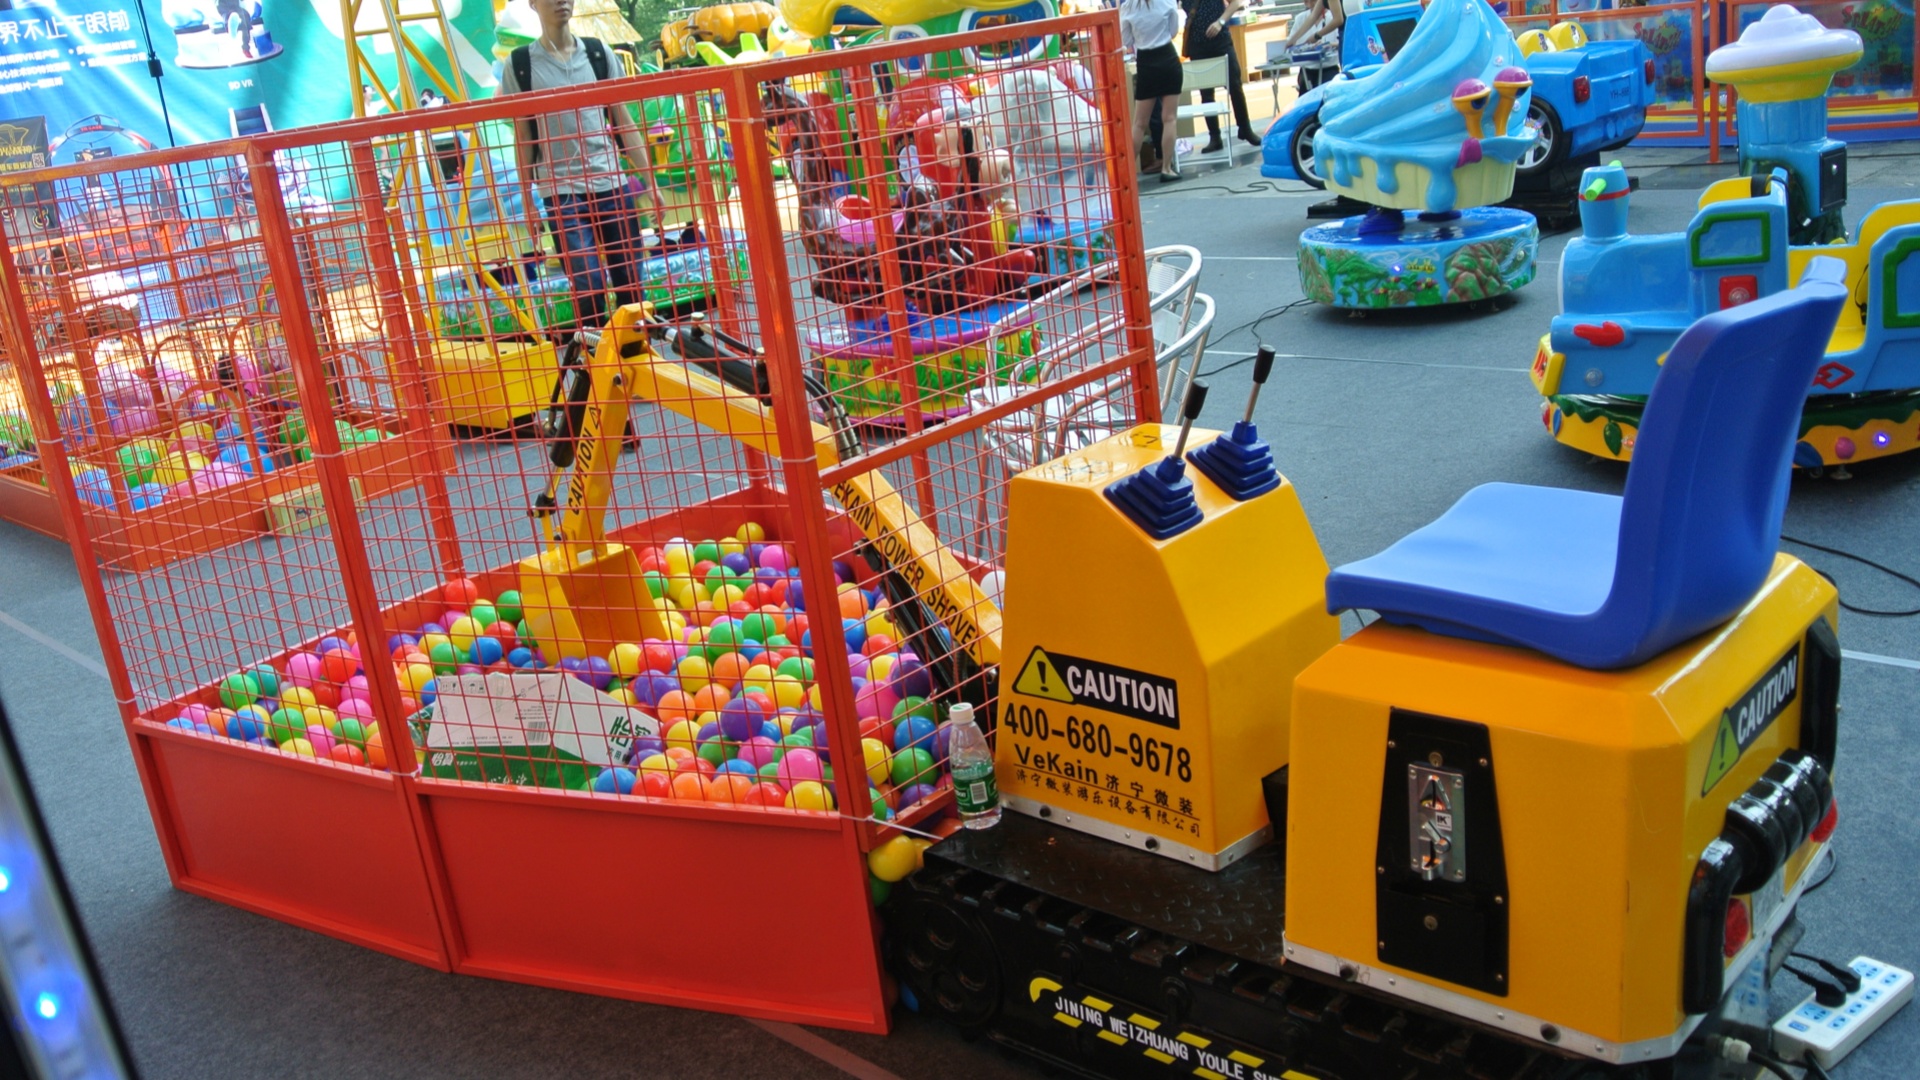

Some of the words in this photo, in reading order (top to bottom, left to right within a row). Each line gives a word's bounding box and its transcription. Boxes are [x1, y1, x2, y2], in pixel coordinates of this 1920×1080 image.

[241, 79, 254, 88] VR
[567, 427, 596, 515] CAUTION
[875, 525, 925, 586] POWER
[927, 588, 980, 657] SHOVEL
[1066, 665, 1176, 719] CAUTION
[1736, 655, 1797, 744] CAUTION
[1004, 702, 1192, 783] 400-680-9678
[1014, 743, 1098, 785] VeKain
[1054, 996, 1103, 1028] JINING
[1109, 1015, 1189, 1061] WEIZHUANG
[1197, 1048, 1244, 1080] YOULE
